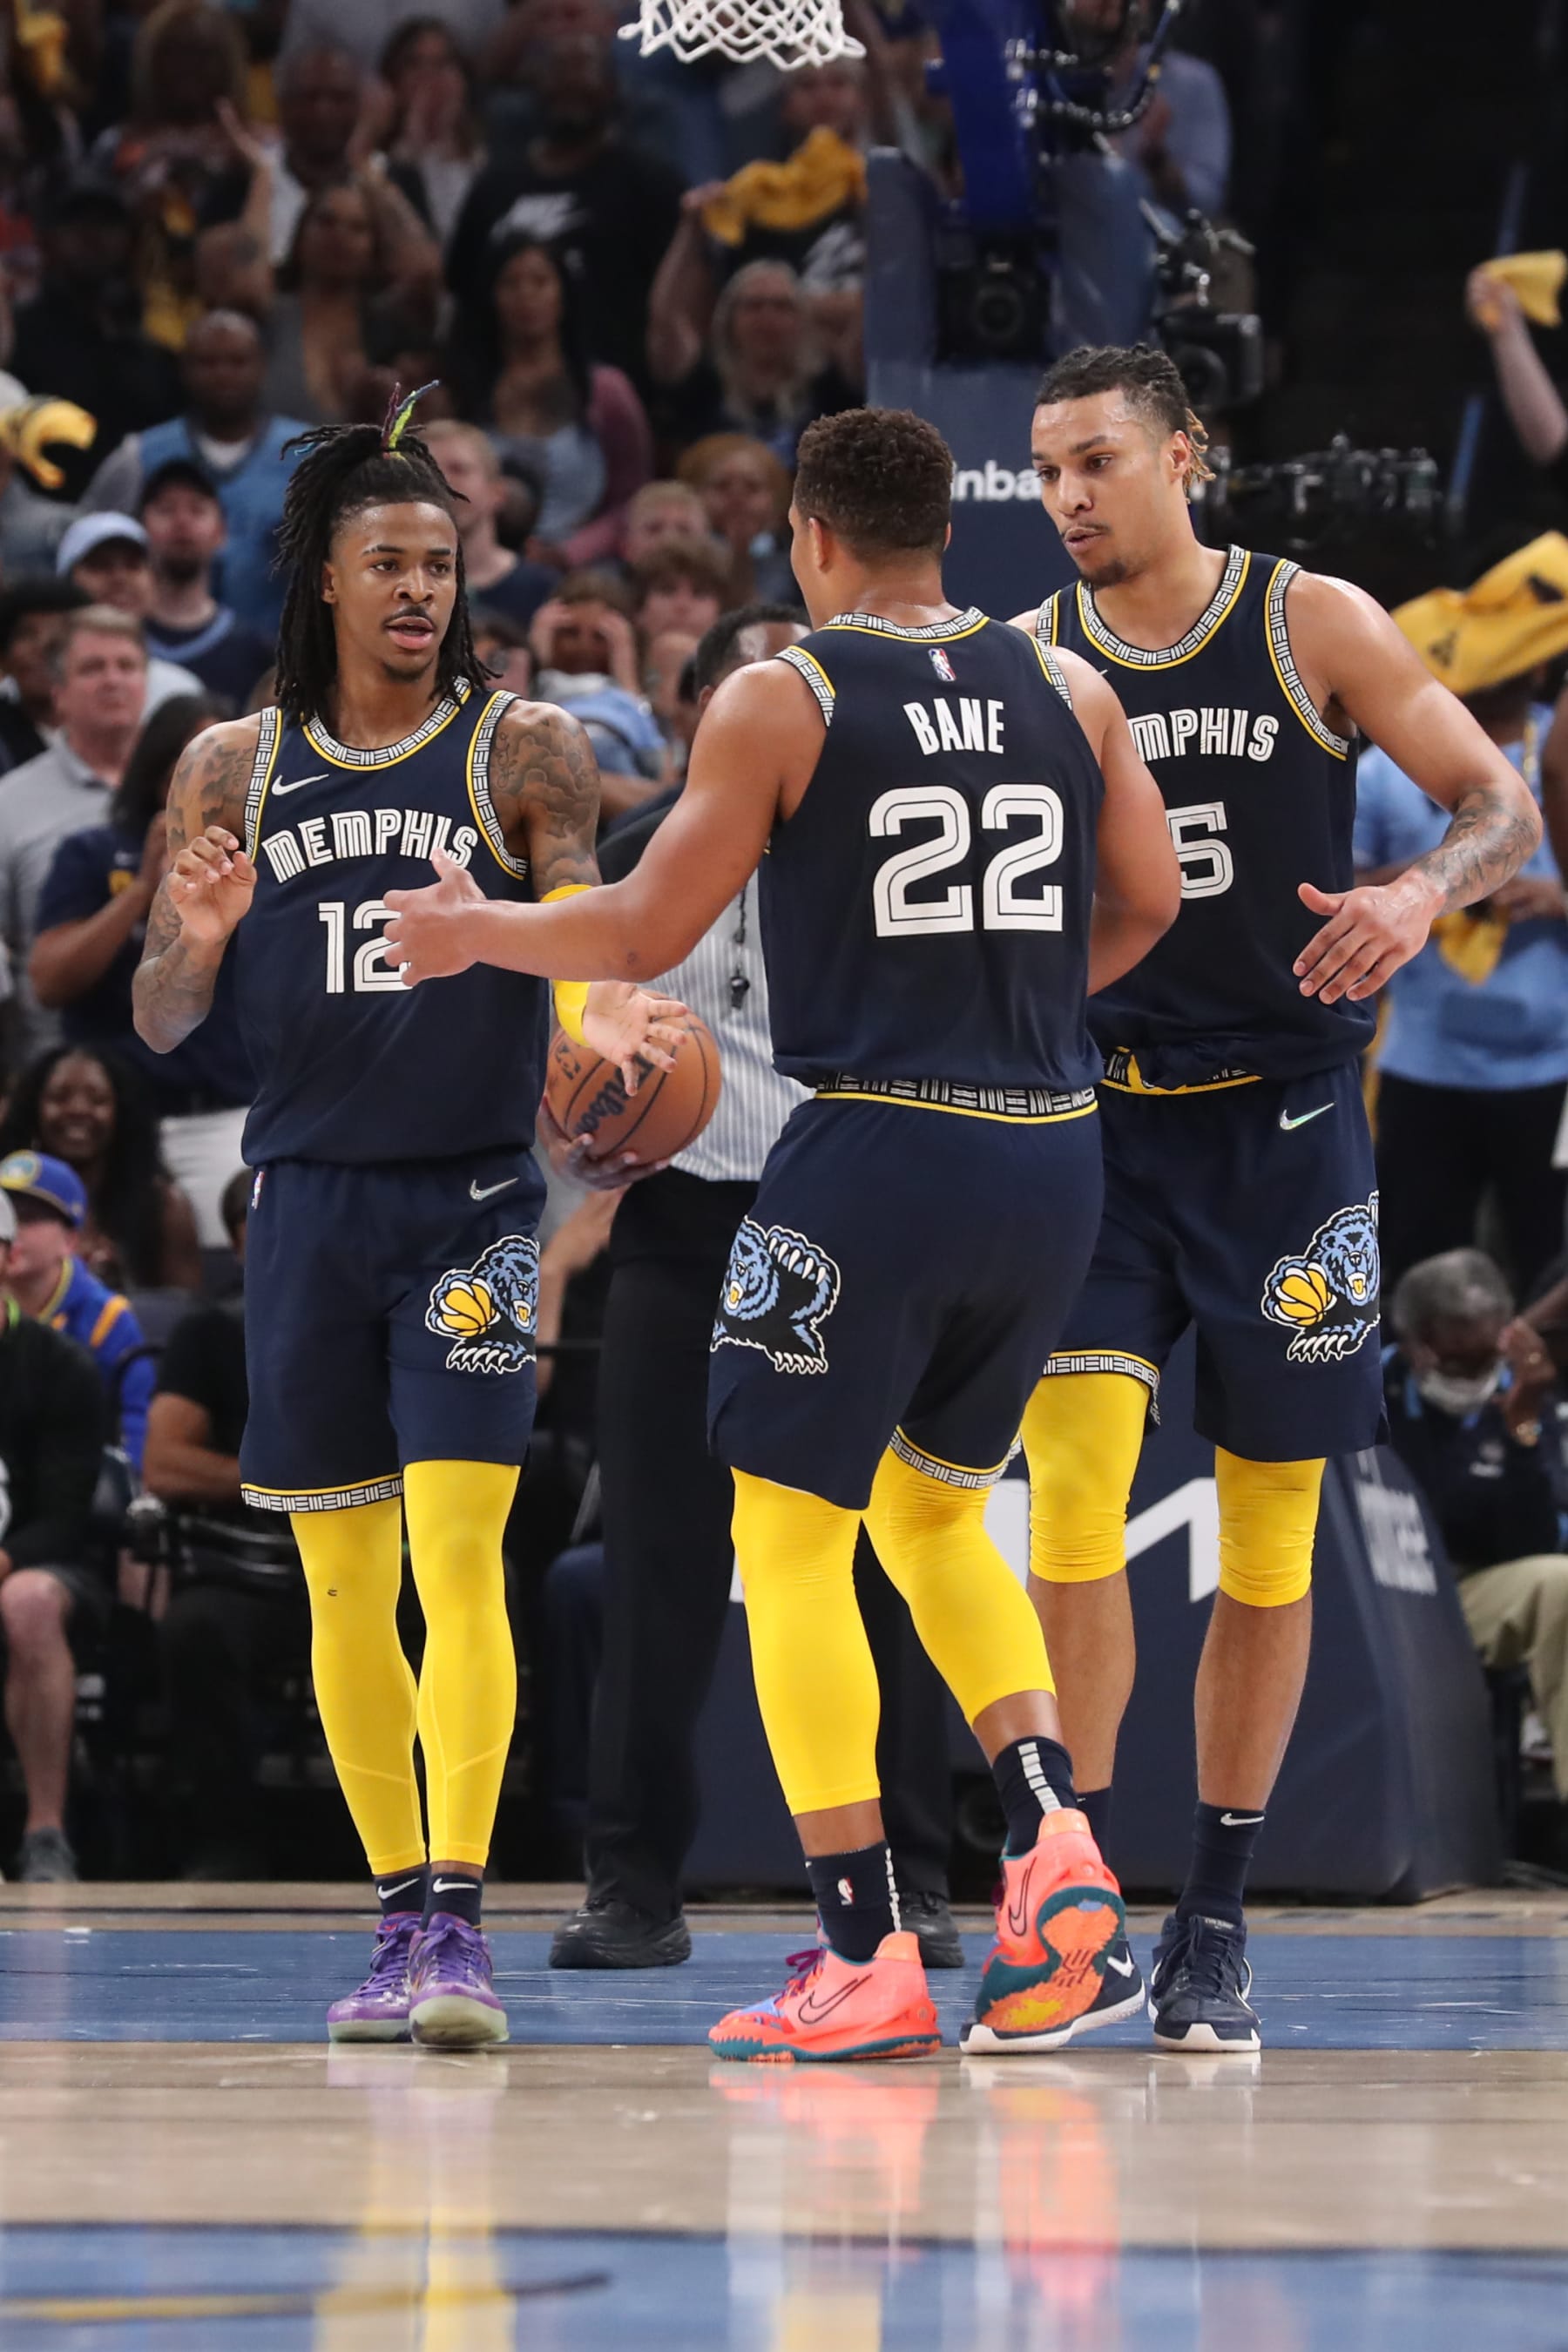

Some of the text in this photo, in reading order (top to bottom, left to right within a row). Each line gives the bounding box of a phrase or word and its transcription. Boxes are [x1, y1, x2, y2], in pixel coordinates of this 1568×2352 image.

[902, 697, 1004, 756] BANE
[261, 808, 478, 884] MEMPHIS
[868, 783, 1063, 938] 22
[318, 899, 416, 994] 12
